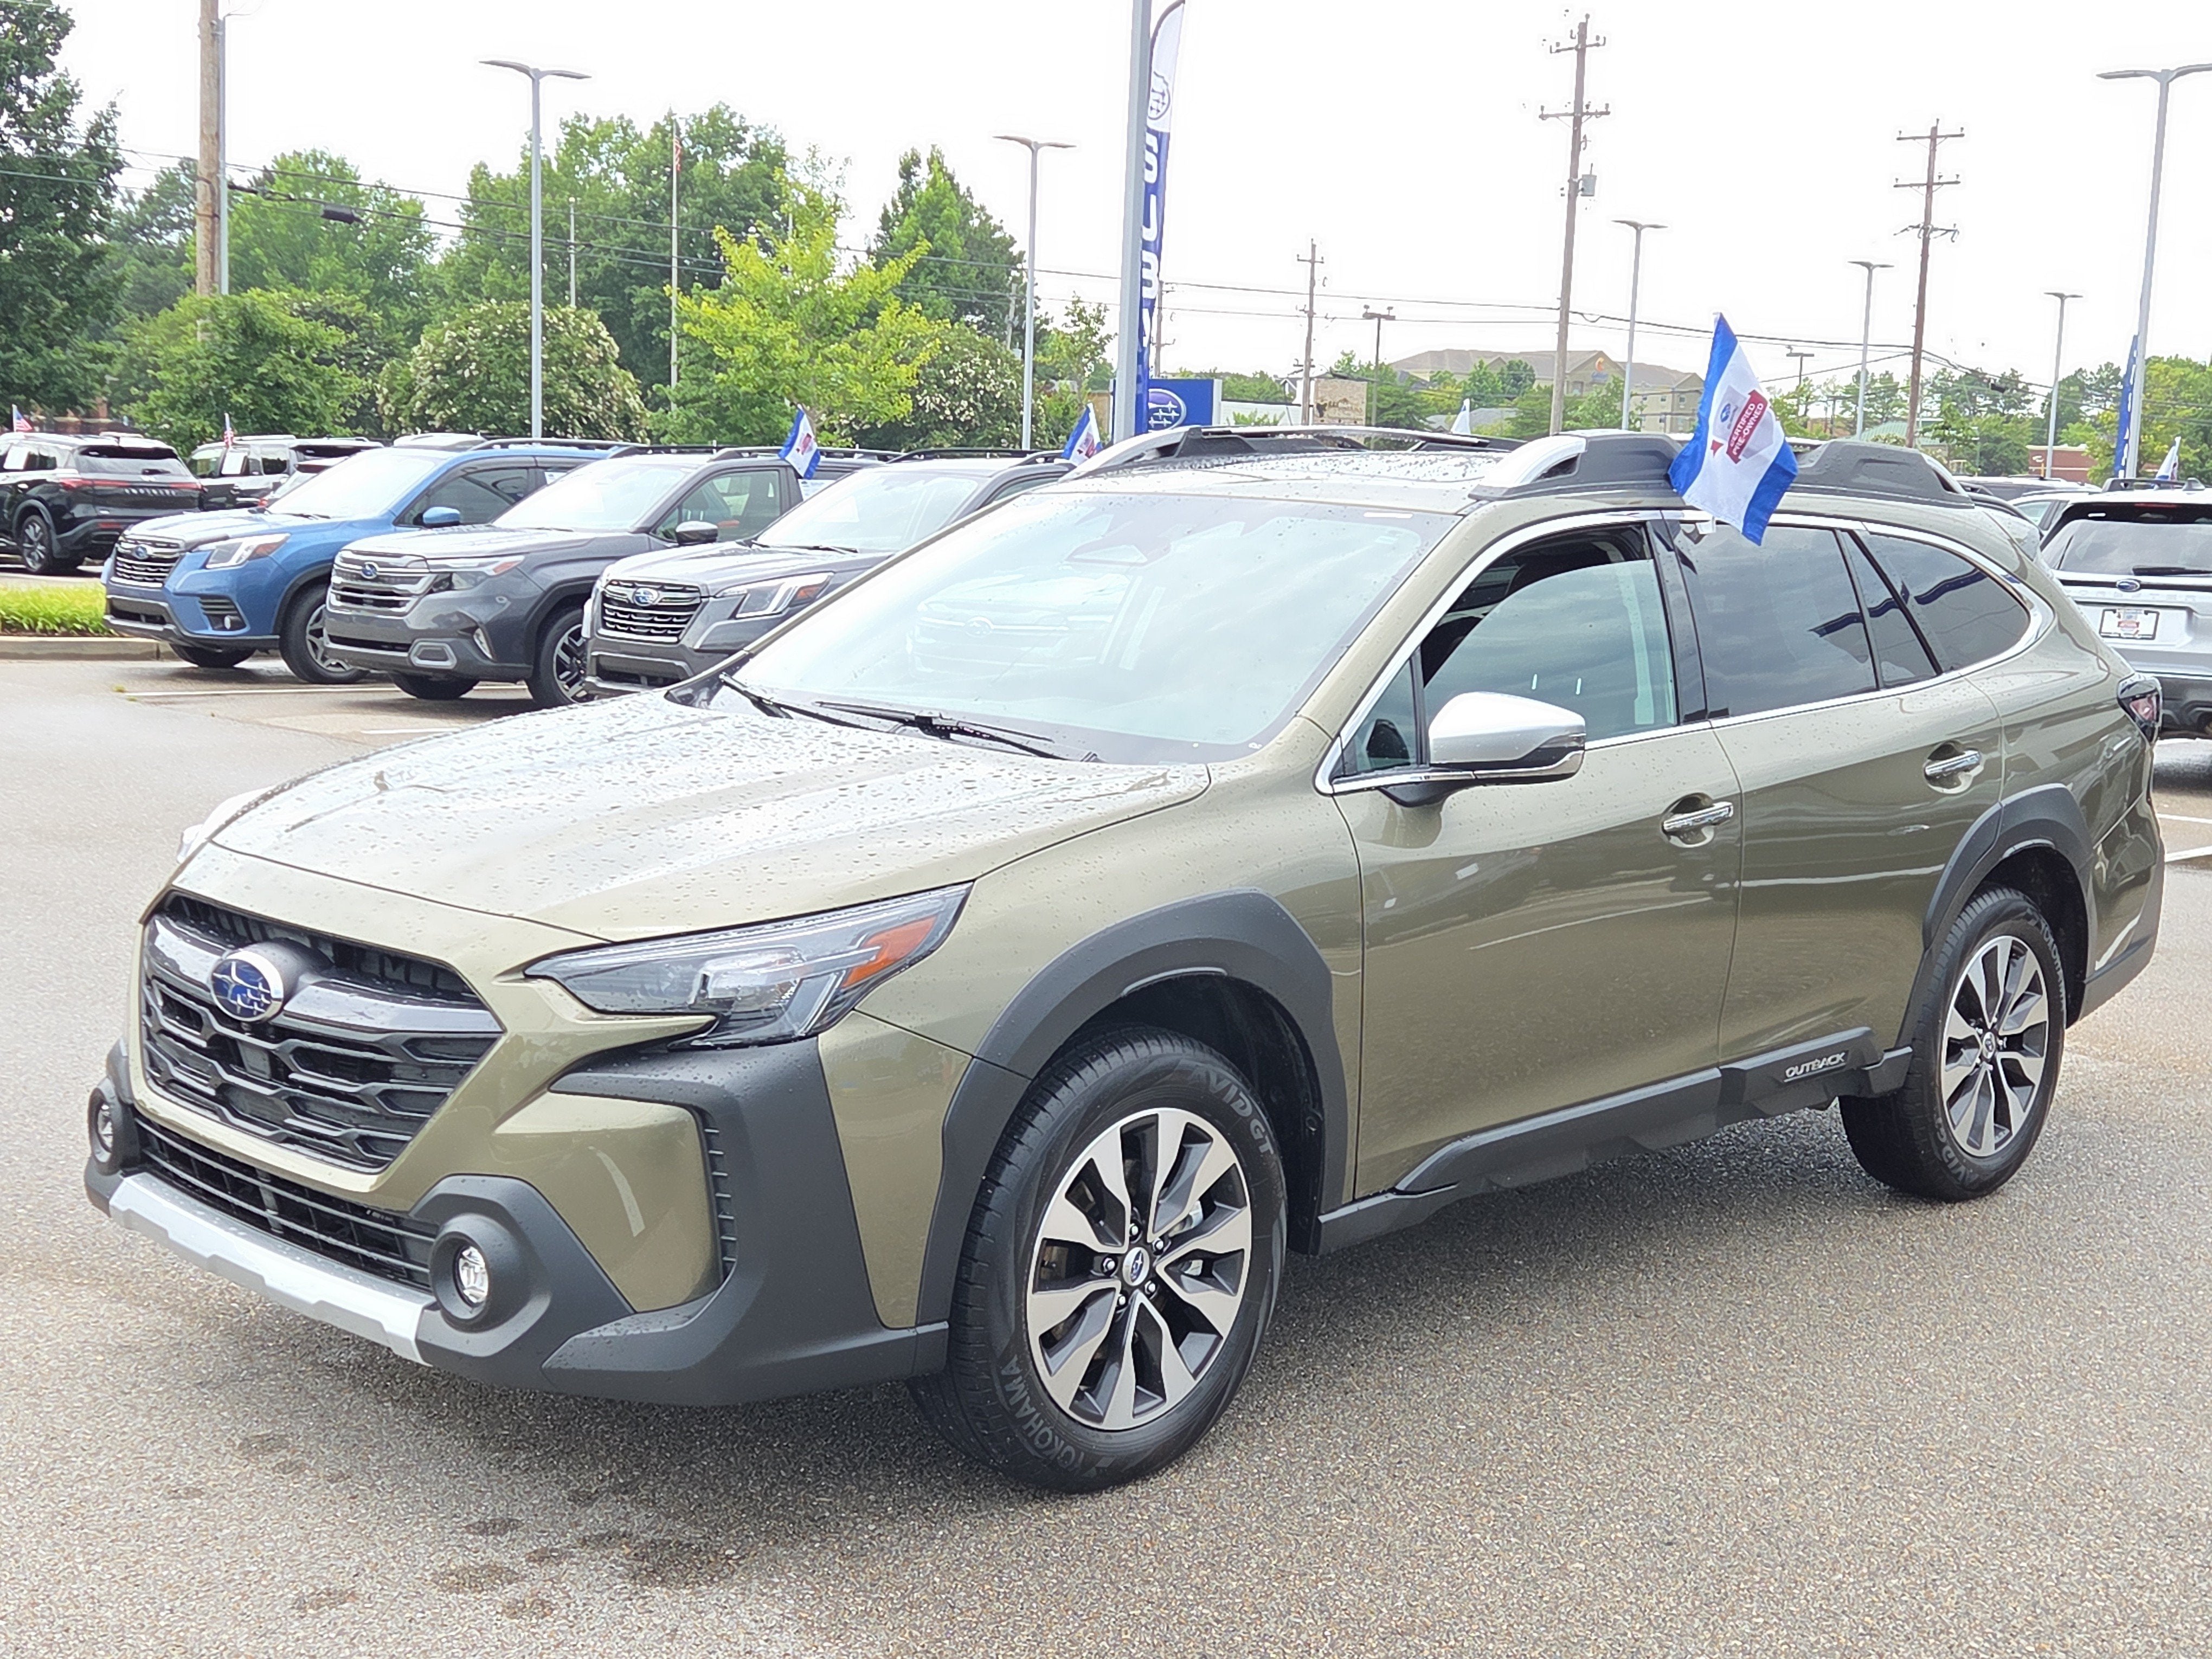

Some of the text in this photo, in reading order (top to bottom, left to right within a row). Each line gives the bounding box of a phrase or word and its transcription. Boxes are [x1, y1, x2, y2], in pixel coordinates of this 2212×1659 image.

[1733, 403, 1764, 454] PRE-OWNED
[1785, 1052, 1846, 1078] OUTBACK
[1249, 1118, 1274, 1155] GT
[1001, 1354, 1084, 1476] YOKOHAMA
